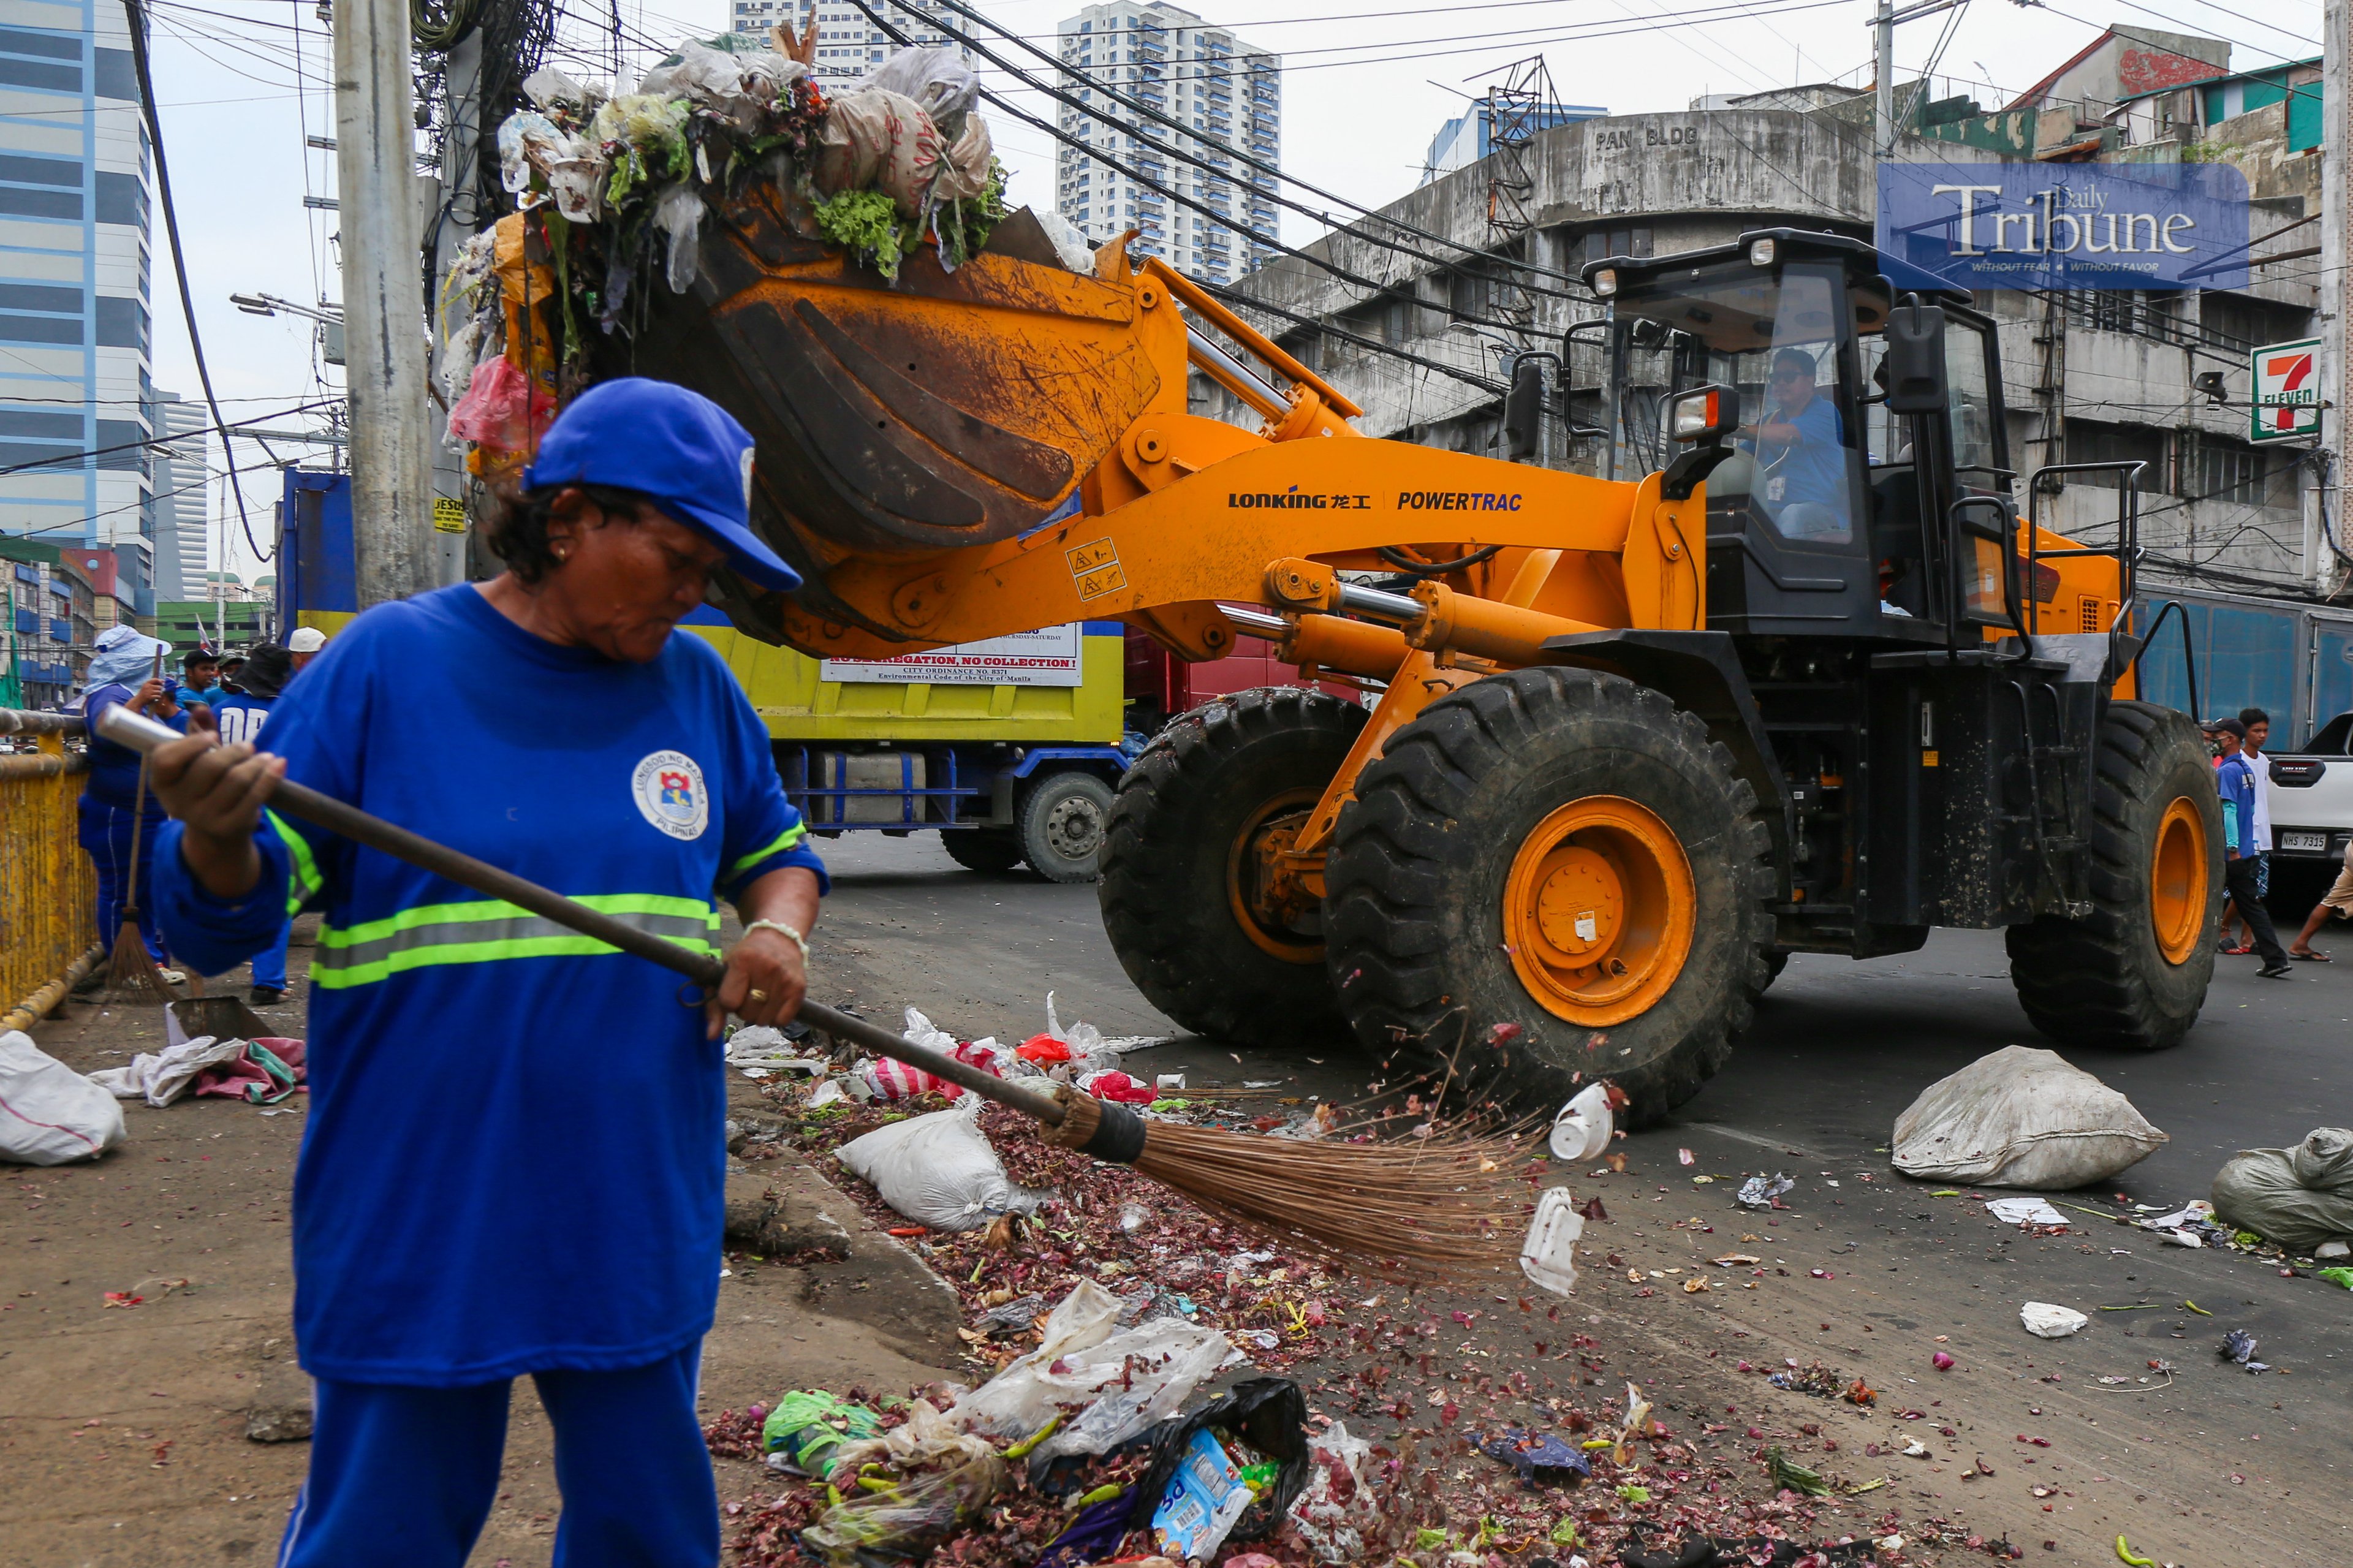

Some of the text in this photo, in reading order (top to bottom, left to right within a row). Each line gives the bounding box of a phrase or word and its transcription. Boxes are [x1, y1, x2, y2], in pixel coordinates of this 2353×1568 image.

[1596, 126, 1697, 151] PAN BLDG
[2267, 353, 2313, 431] 7
[1331, 495, 1371, 509] 龙工
[1397, 491, 1522, 511] POWERTRAC
[637, 755, 665, 791] LUNGSOD
[669, 754, 683, 763] NG
[656, 817, 698, 837] PILIPINAS
[2283, 836, 2324, 847] NHS 7315
